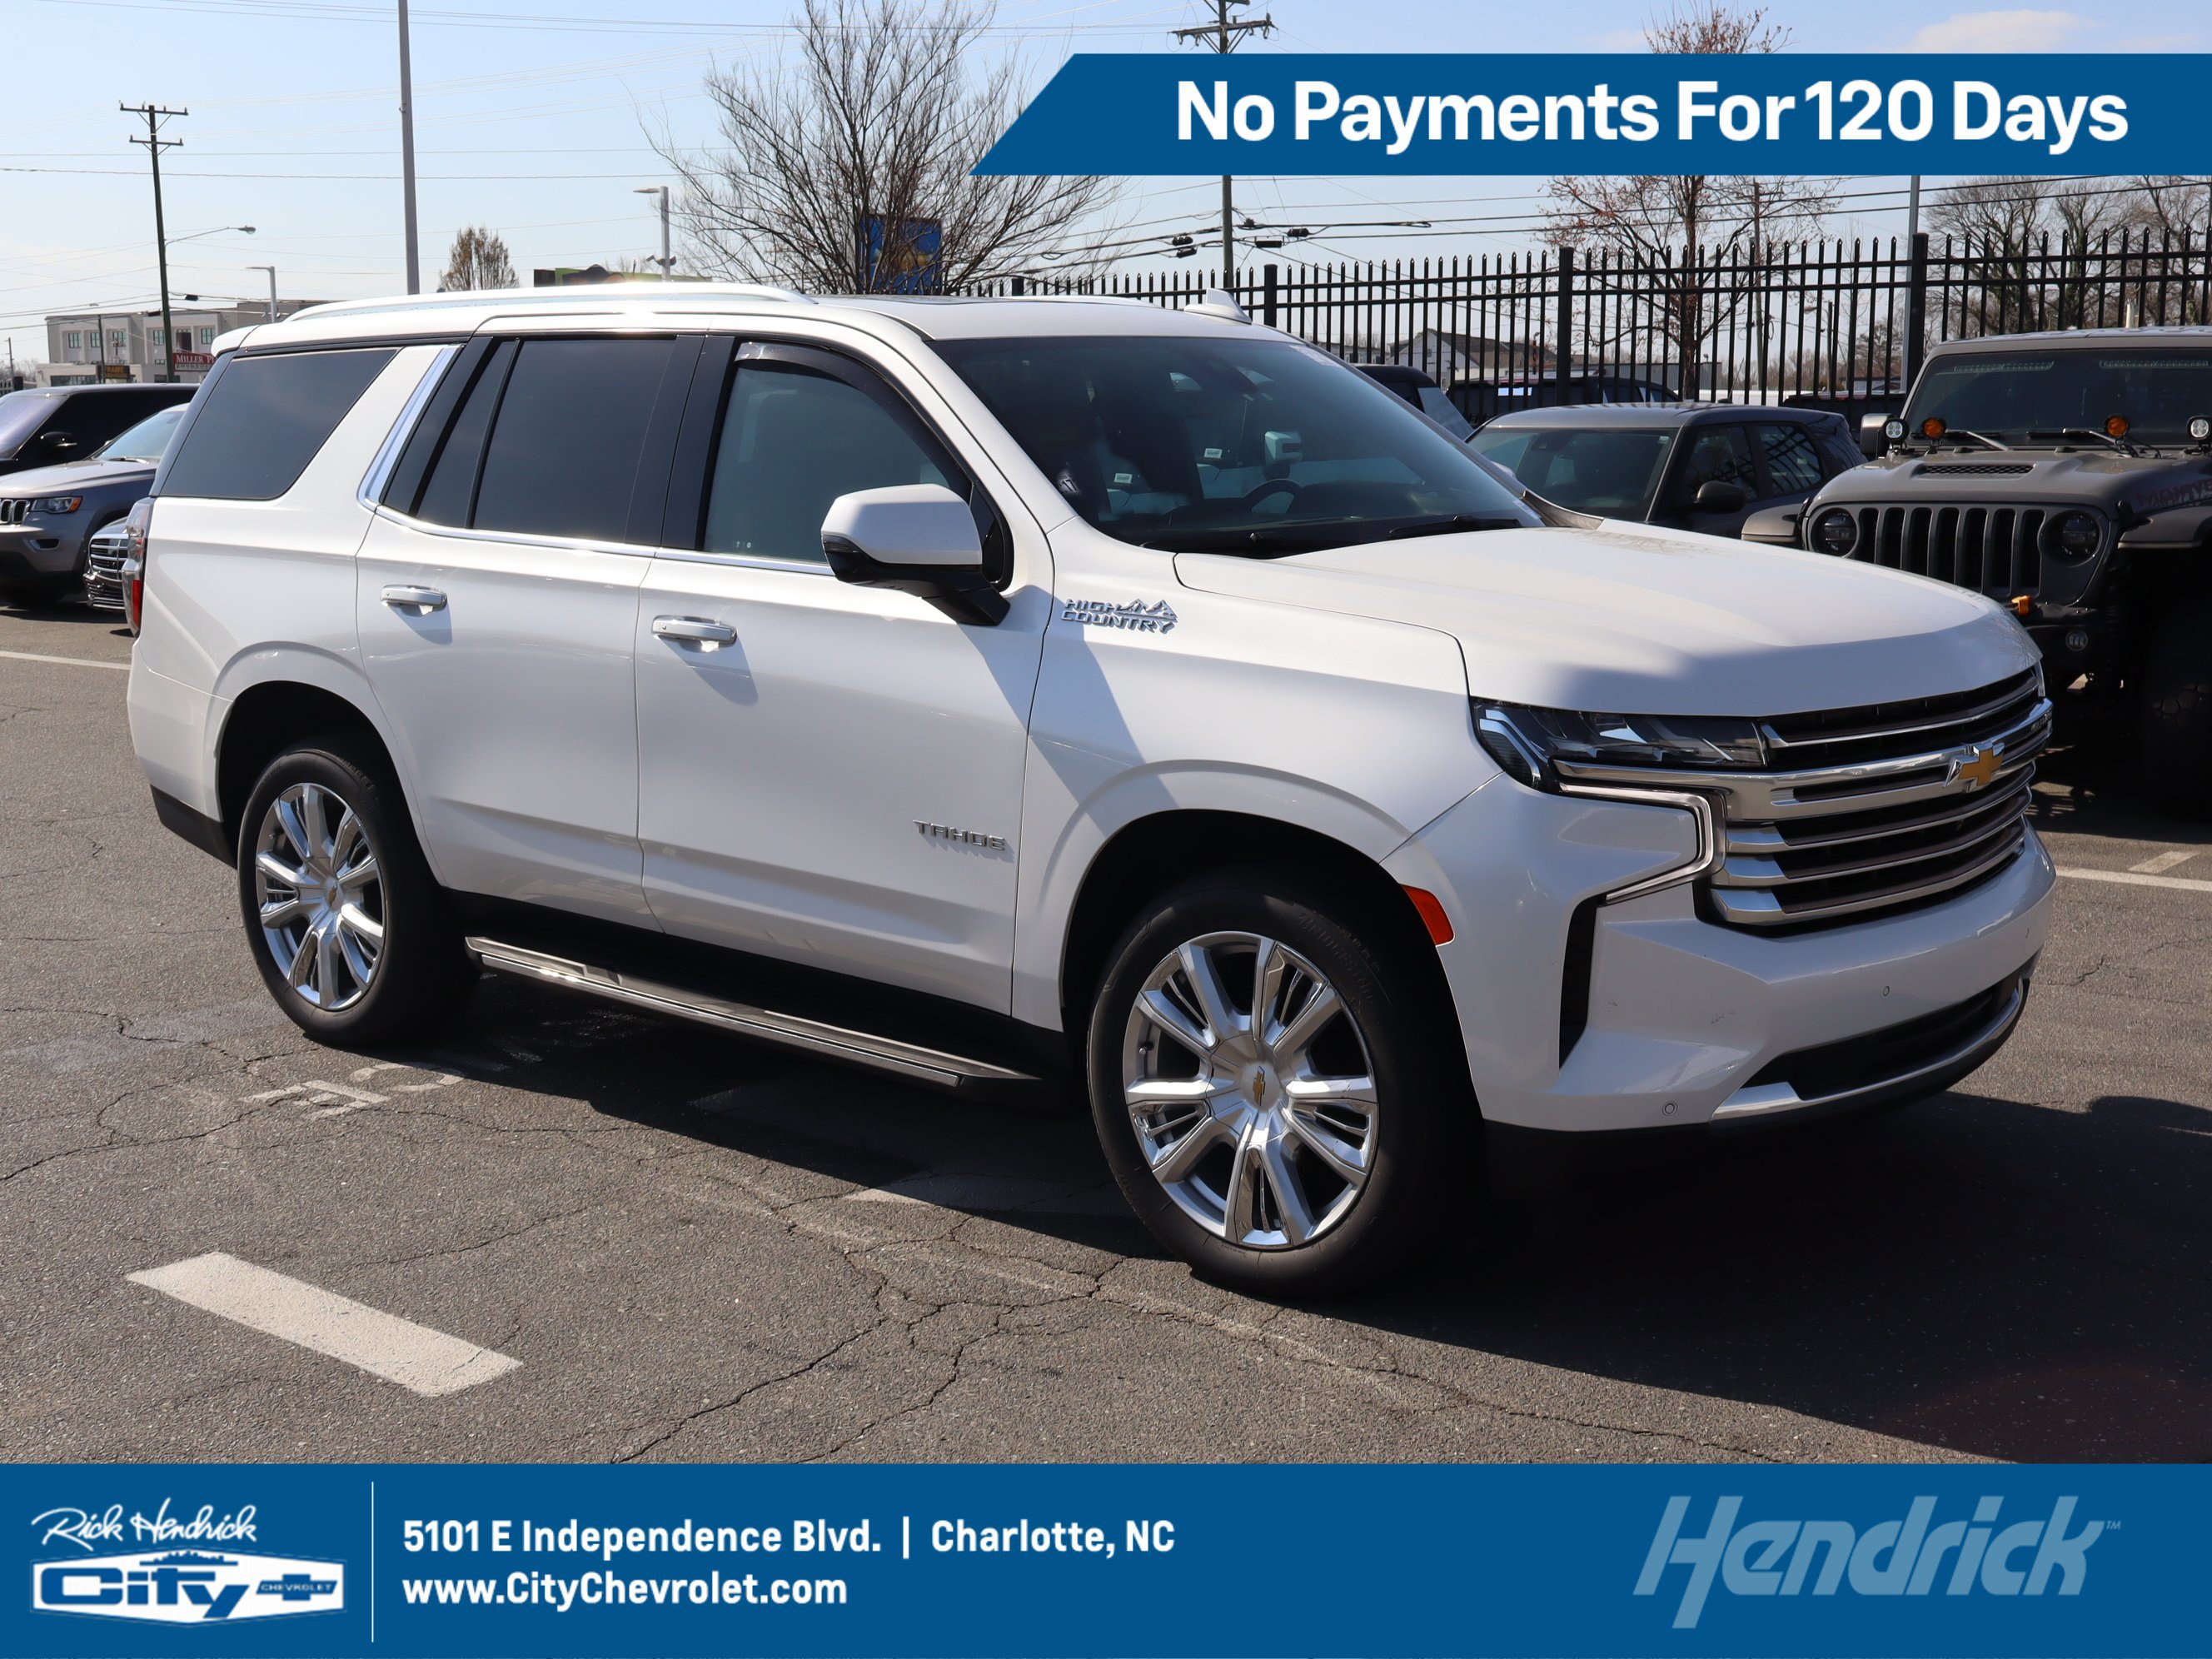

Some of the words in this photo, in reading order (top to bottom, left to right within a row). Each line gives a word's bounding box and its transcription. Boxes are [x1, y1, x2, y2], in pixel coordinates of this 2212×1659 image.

[176, 354, 204, 363] MILLER
[1064, 599, 1123, 614] HIGH
[1061, 610, 1175, 635] COUNTRY
[912, 820, 1005, 851] TAHOE
